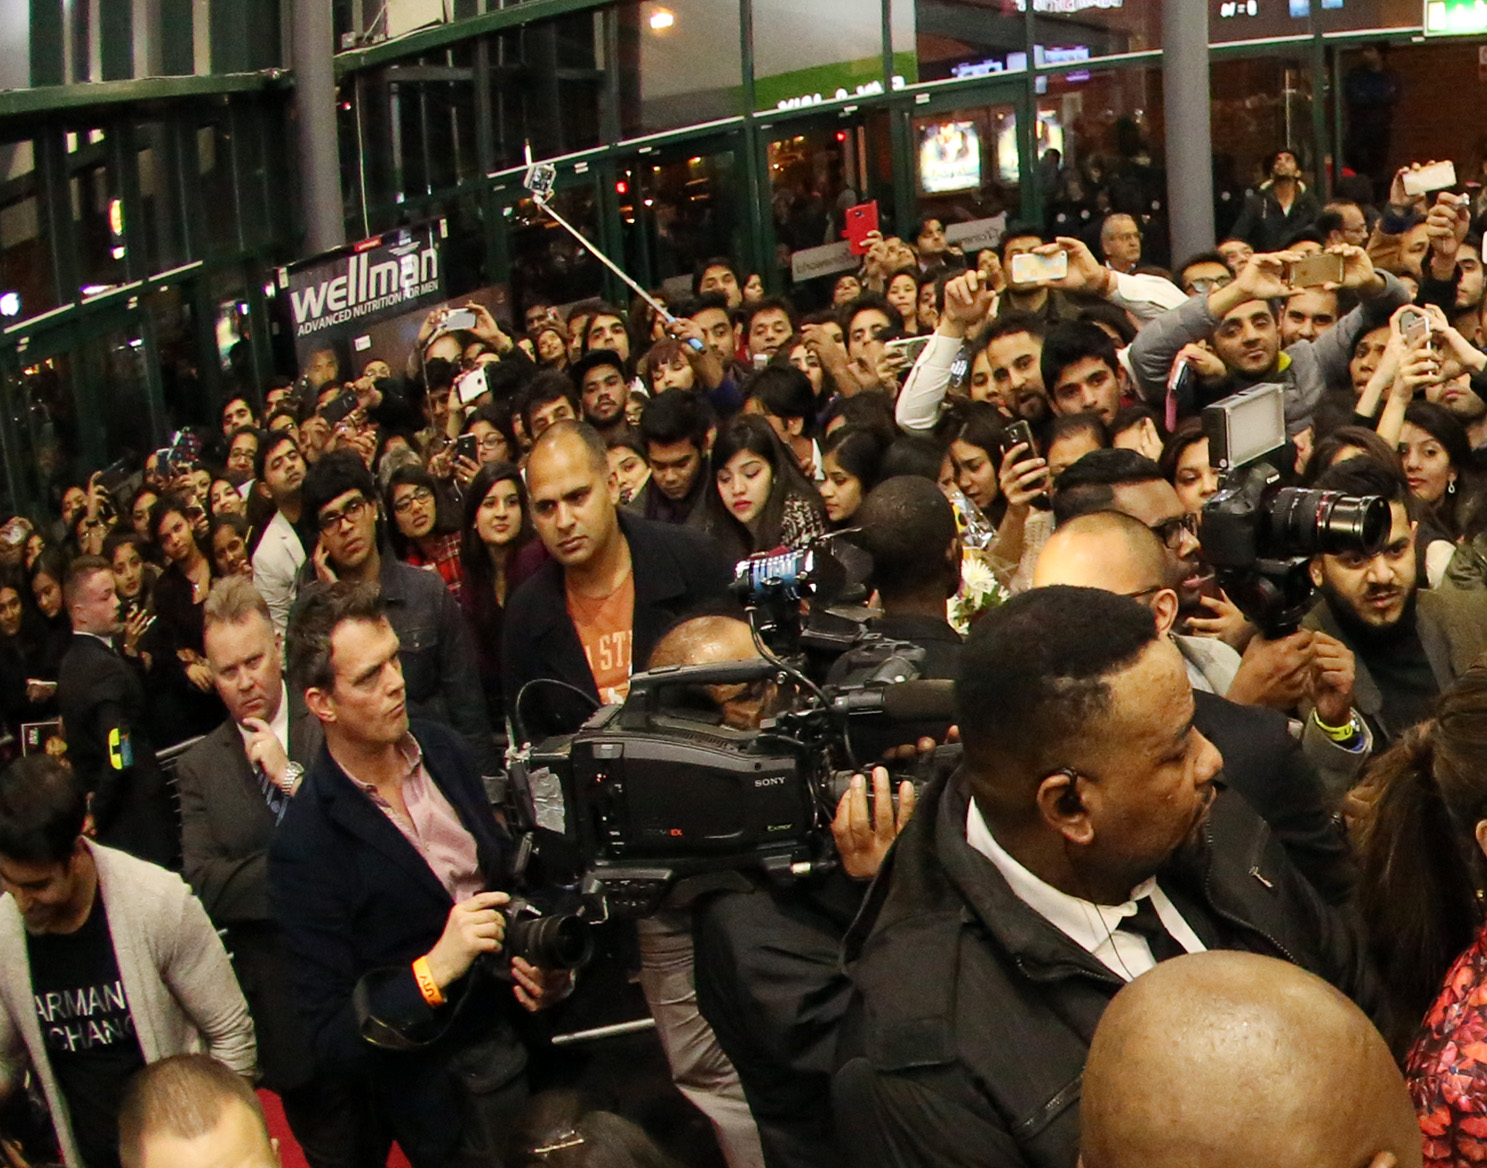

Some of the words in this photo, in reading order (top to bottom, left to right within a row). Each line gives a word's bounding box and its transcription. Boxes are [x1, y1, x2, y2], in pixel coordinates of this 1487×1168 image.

[290, 248, 438, 324] wellman
[297, 310, 352, 337] ADVANCED
[352, 291, 402, 317] NUTRITION
[419, 279, 439, 294] MEN
[754, 776, 786, 788] SONY
